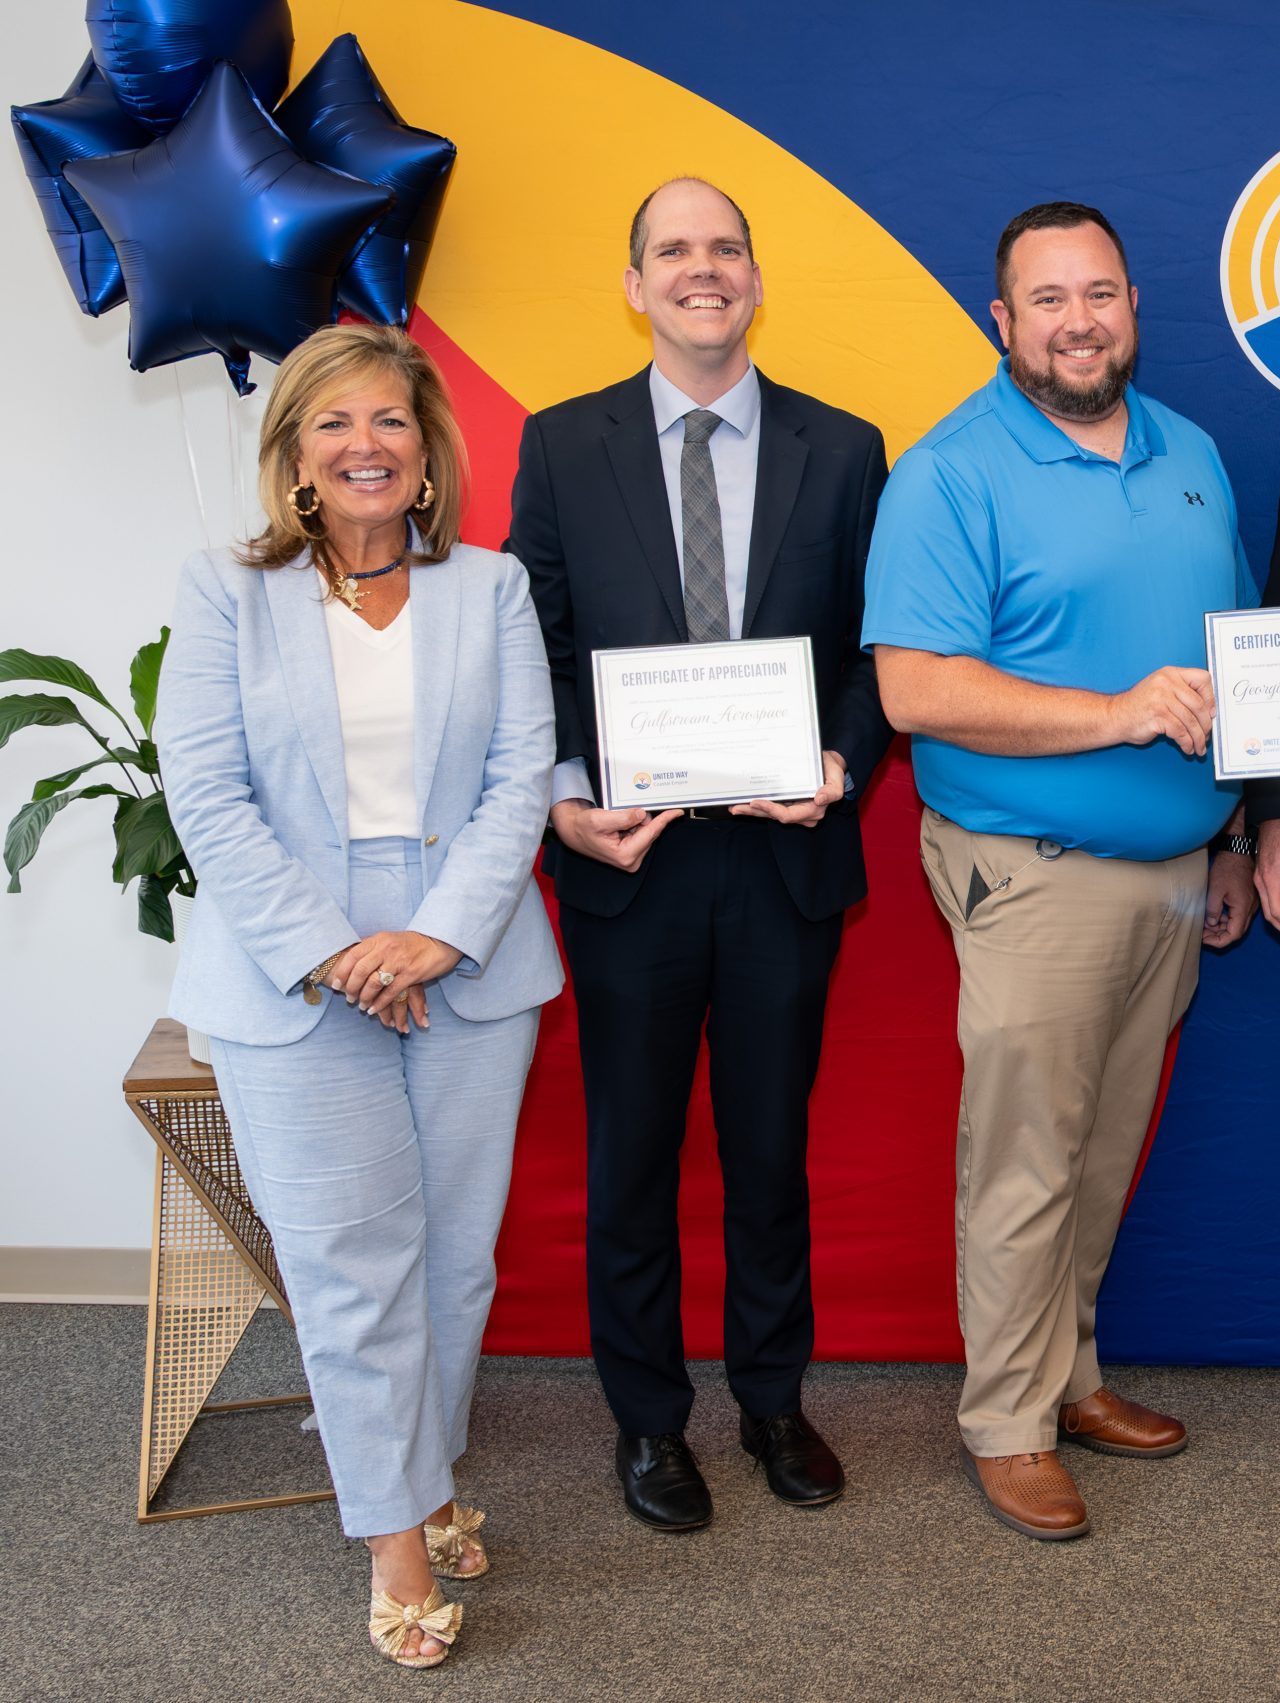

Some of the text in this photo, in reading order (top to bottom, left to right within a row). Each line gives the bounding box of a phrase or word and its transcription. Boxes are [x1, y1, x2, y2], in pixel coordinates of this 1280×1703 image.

[621, 661, 788, 687] CERTIFICATE OF APPRECIATION
[630, 703, 789, 736] Gulfstream Aerospace
[652, 770, 689, 781] UNITED WAY
